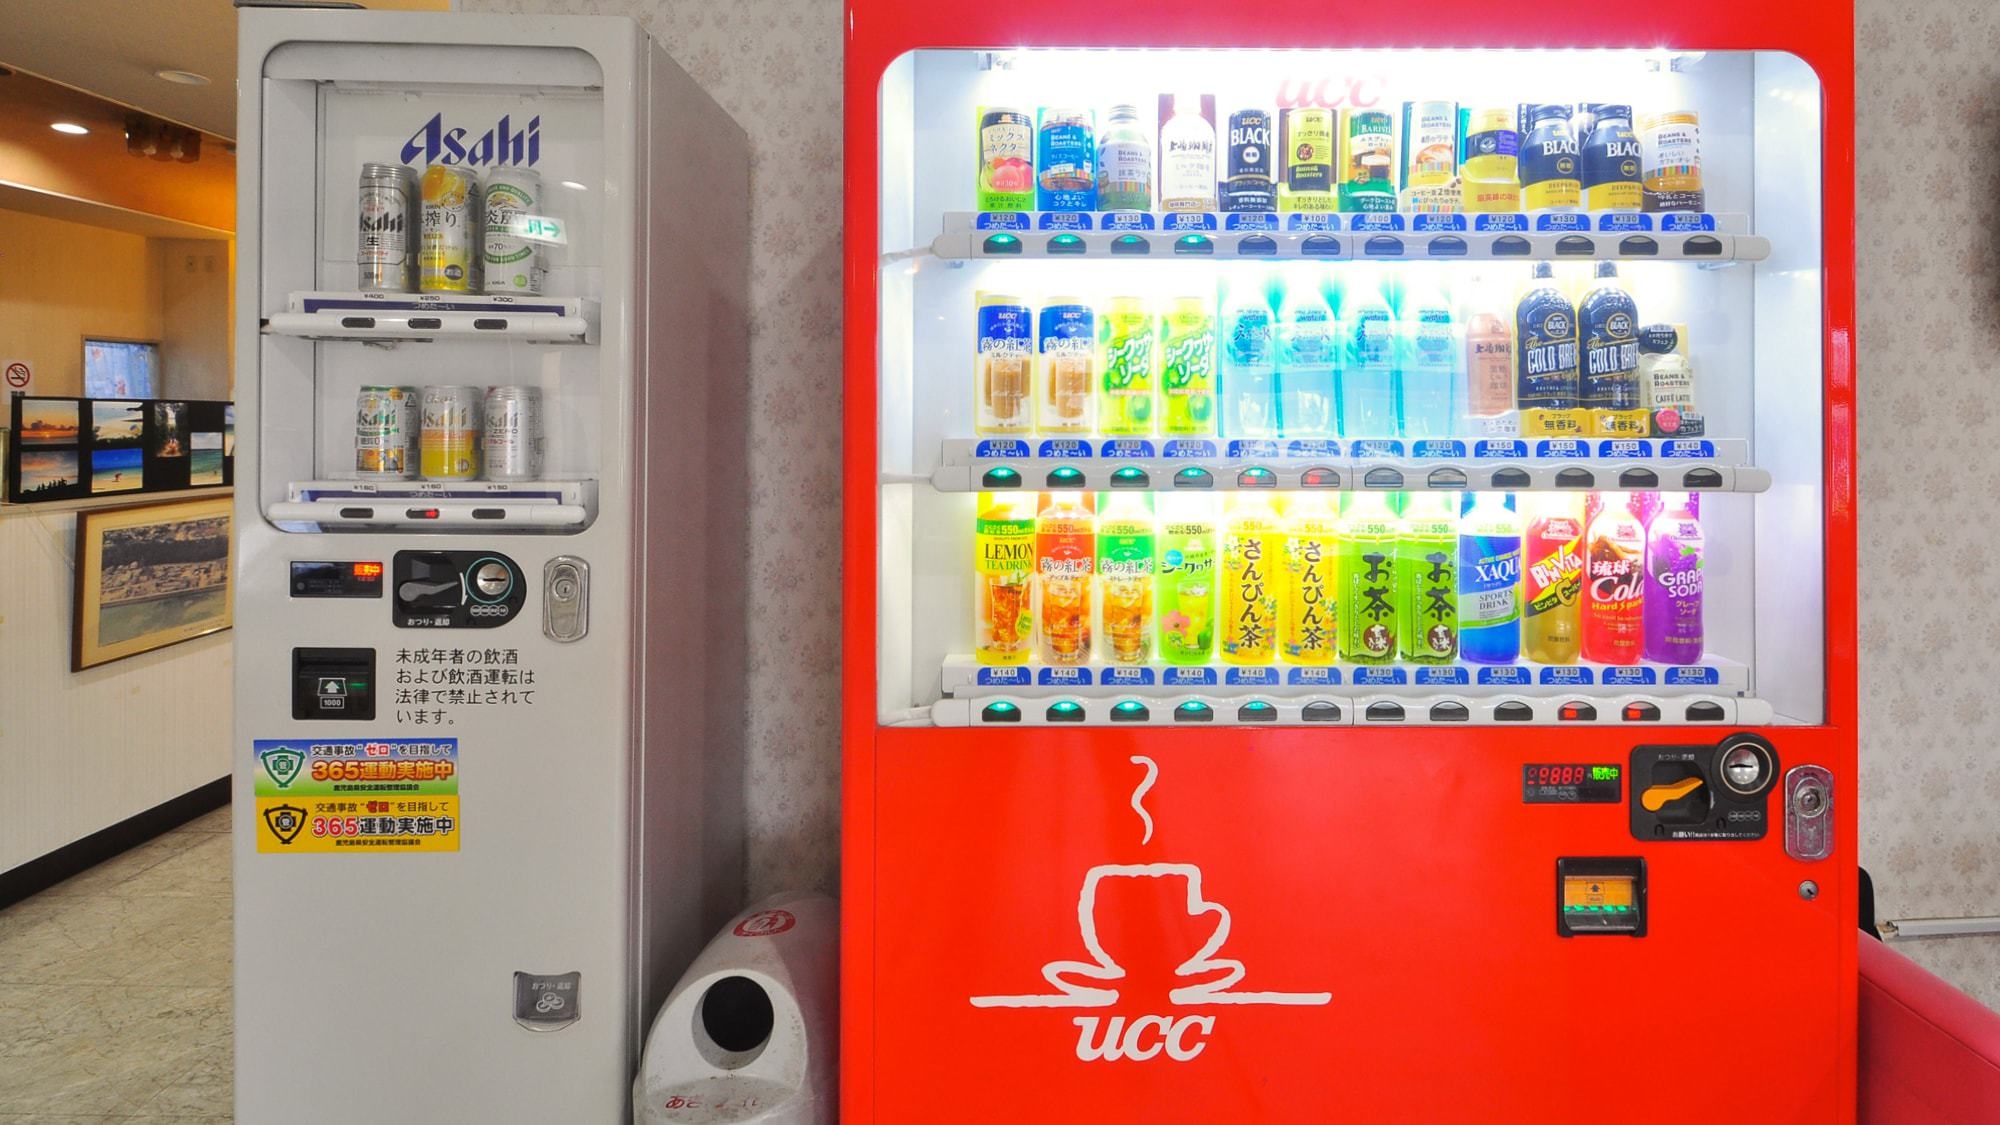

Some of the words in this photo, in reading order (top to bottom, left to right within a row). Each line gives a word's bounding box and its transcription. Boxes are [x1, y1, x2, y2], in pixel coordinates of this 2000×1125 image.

[400, 112, 540, 168] Asahi
[1230, 128, 1271, 148] BLACK
[1116, 214, 1140, 222] ¥130
[1179, 215, 1201, 223] ¥130
[1303, 215, 1327, 223] ¥100
[1547, 321, 1565, 330] BLACK
[1610, 321, 1628, 330] BLACK
[1527, 345, 1556, 375] COLD
[1588, 345, 1618, 375] COLD
[1653, 373, 1680, 381] BEANS
[1543, 419, 1578, 431] 無香料
[991, 441, 1015, 449] ¥120
[1054, 441, 1077, 449] ¥120
[1489, 441, 1513, 449] ¥150
[1551, 441, 1575, 449] ¥150
[1614, 441, 1638, 449] ¥150
[1676, 441, 1699, 449] ¥140
[1186, 525, 1202, 535] 550
[1367, 524, 1386, 534] 550
[1431, 524, 1449, 534] 550
[986, 560, 1005, 570] TEA
[1040, 558, 1092, 573] 霧の紅茶
[1101, 559, 1153, 574] 霧の紅茶
[1591, 559, 1631, 577] 琉球
[1360, 551, 1395, 622] お茶
[1424, 551, 1456, 622] お茶
[1238, 538, 1264, 649] さんぴん茶
[1301, 541, 1325, 650] さんぴん茶
[1479, 589, 1514, 602] SPORTS
[1479, 599, 1509, 610] DRINK
[1591, 601, 1618, 611] Hard
[395, 648, 518, 665] 未成年者の飲酒
[396, 668, 536, 685] および飲酒運転は
[395, 689, 536, 705] 法律で禁止されて
[396, 709, 456, 725] います。
[311, 760, 454, 781] 365運動実施中
[1592, 766, 1619, 780] 販売中
[311, 816, 455, 838] 365運動実施中
